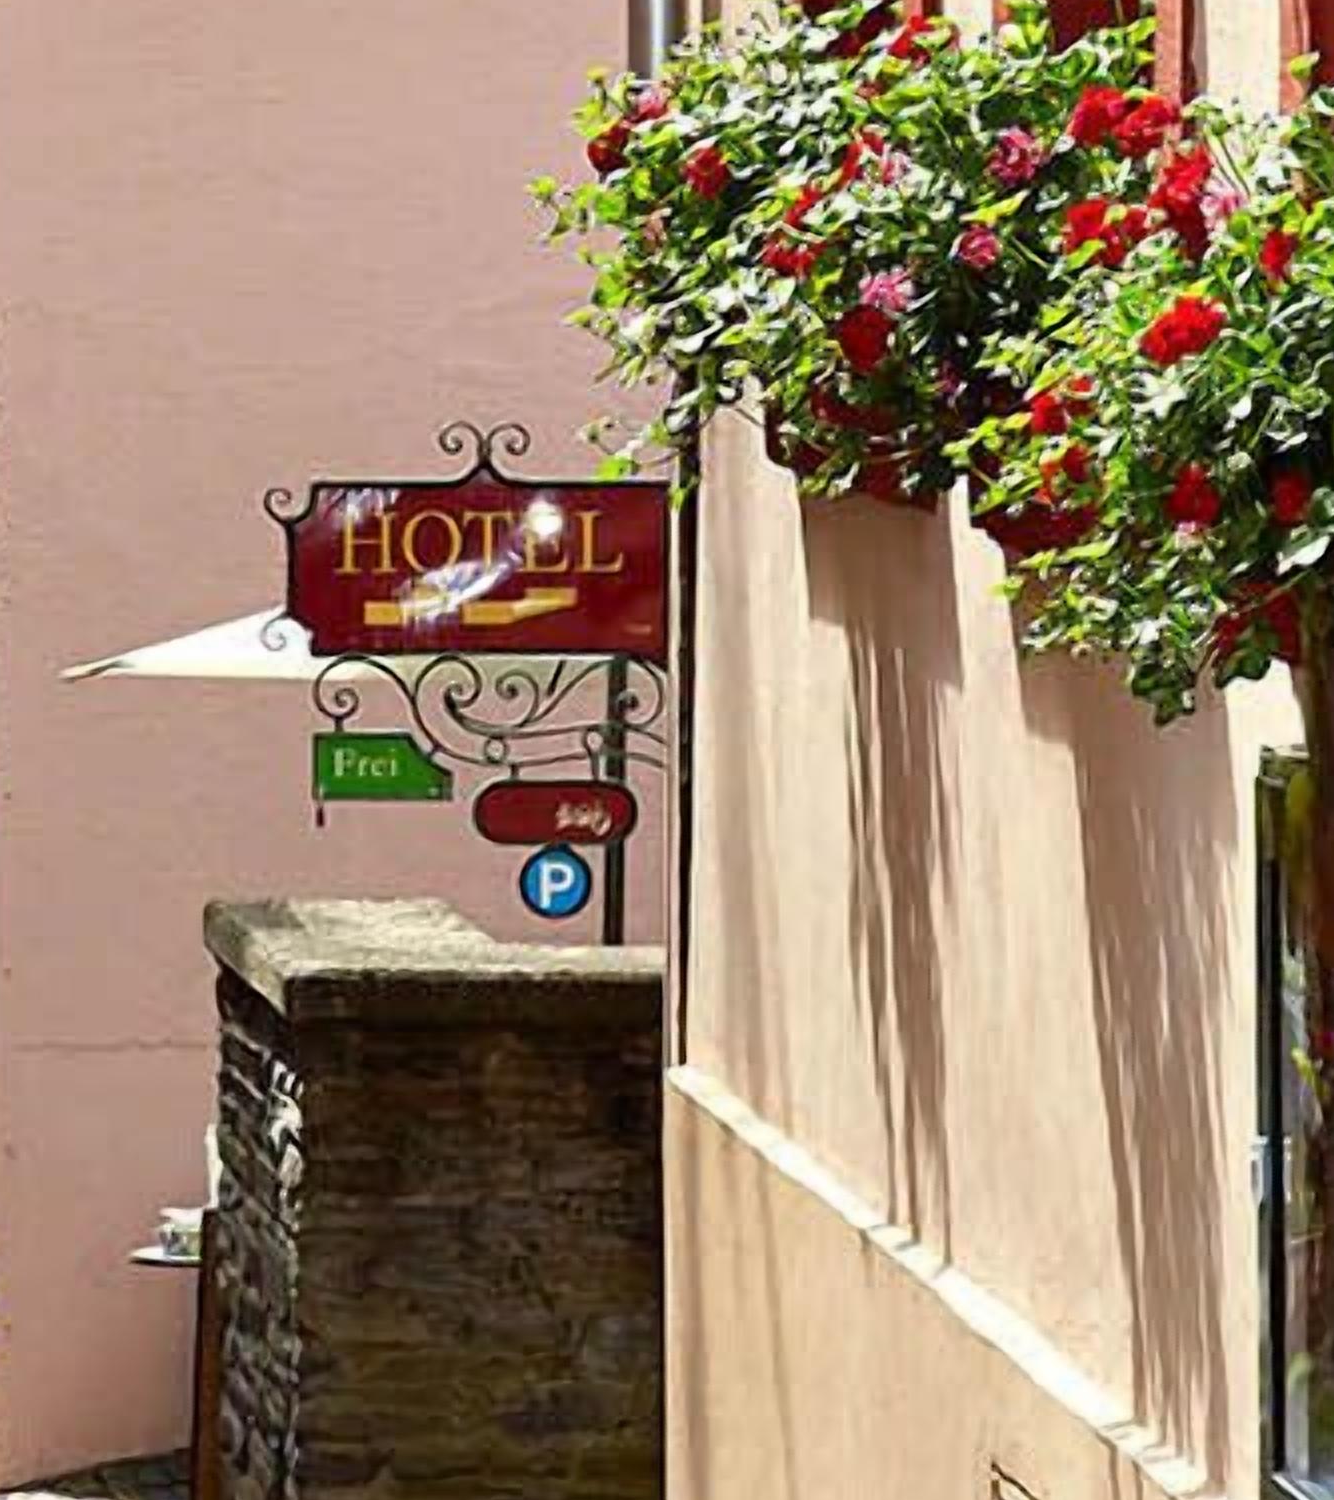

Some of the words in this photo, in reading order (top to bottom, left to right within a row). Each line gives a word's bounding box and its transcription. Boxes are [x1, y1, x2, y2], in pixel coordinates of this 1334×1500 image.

[333, 509, 625, 575] HOTEL
[332, 747, 399, 778] Frei
[539, 862, 576, 909] P
